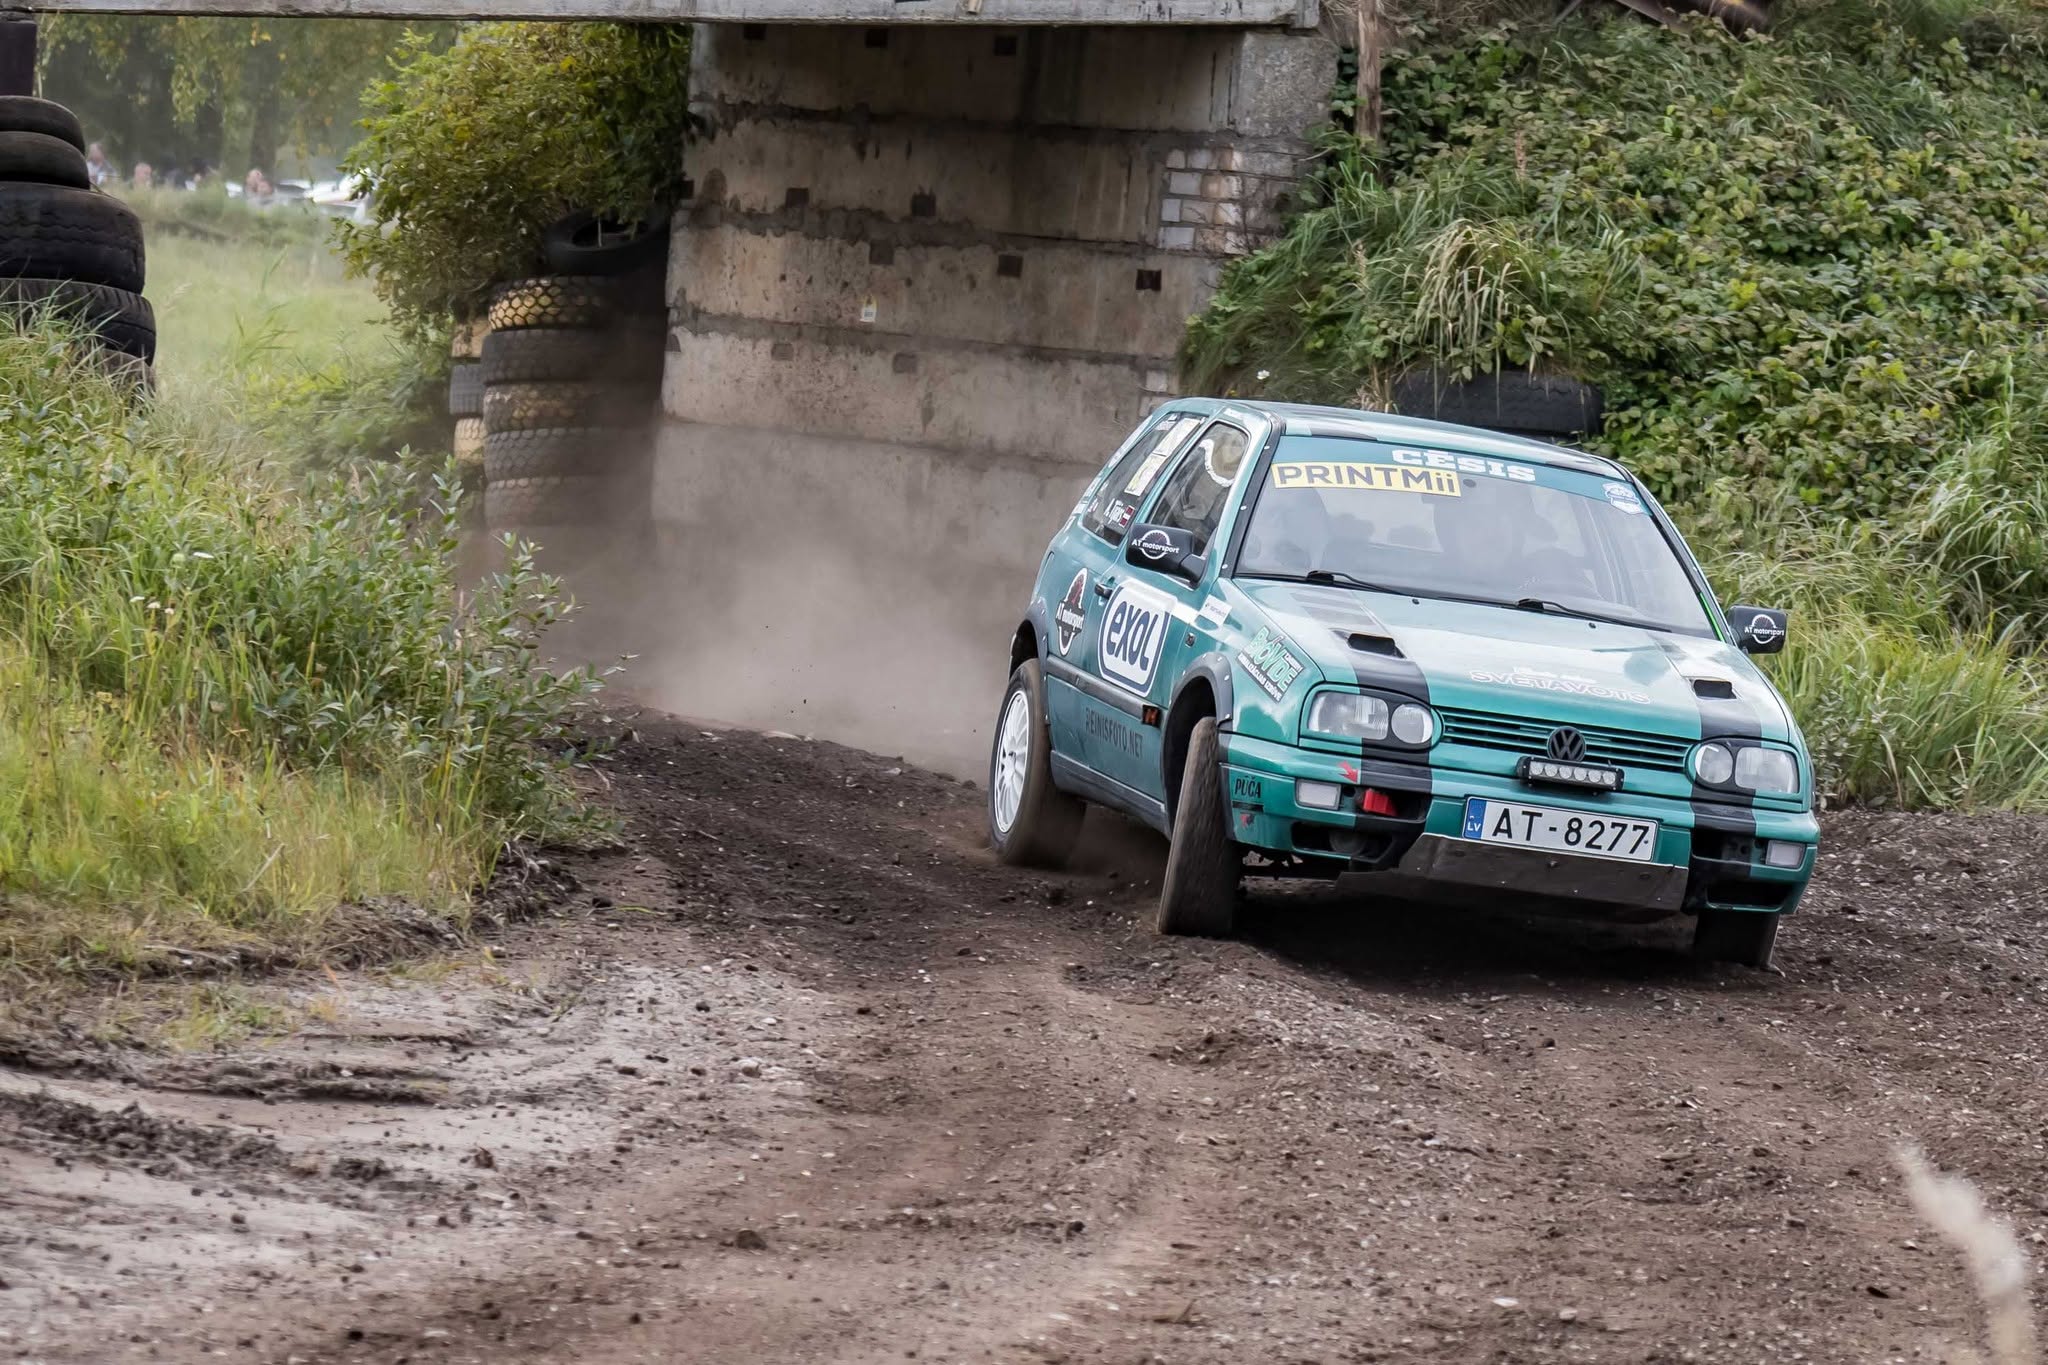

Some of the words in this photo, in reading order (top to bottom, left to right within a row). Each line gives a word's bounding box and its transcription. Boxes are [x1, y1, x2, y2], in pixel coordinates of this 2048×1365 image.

[1277, 465, 1456, 493] PRINTMii
[1131, 538, 1143, 547] AT
[1142, 542, 1180, 554] motorsport
[1744, 626, 1753, 634] AT
[1753, 628, 1785, 637] motorsport
[1467, 822, 1481, 832] LV
[1492, 808, 1650, 855] AT-8277
